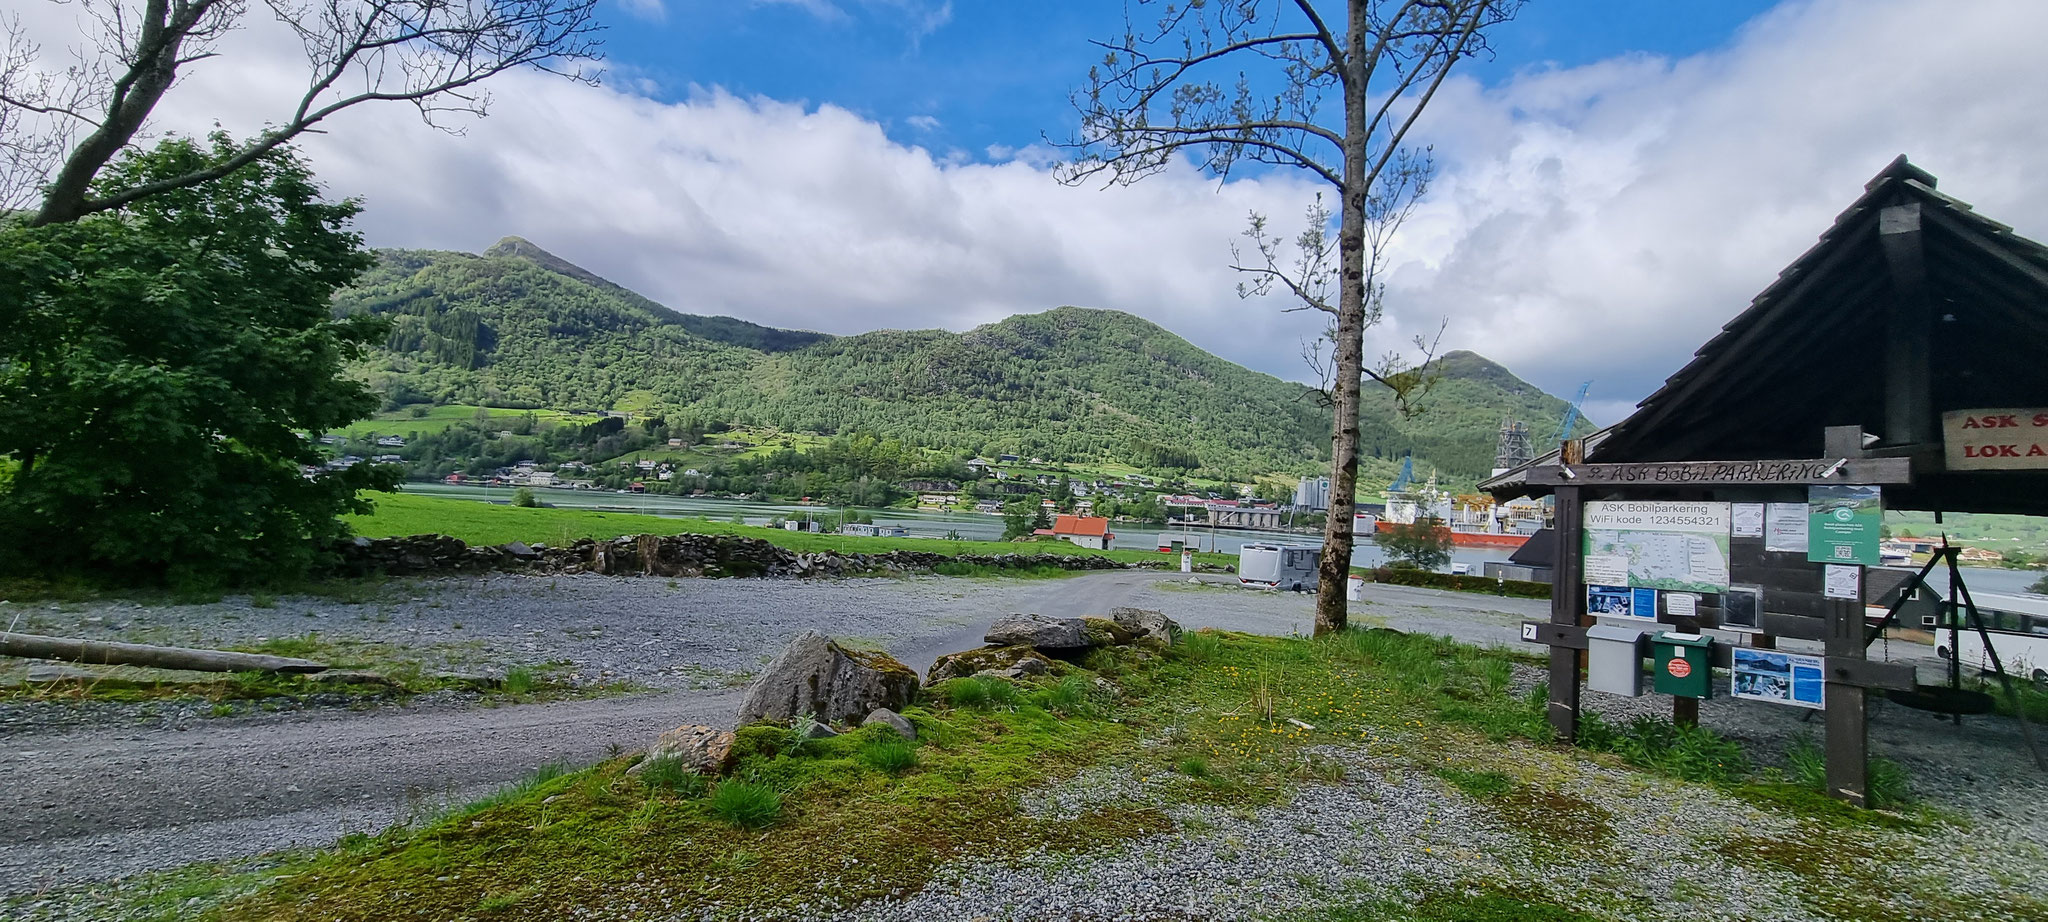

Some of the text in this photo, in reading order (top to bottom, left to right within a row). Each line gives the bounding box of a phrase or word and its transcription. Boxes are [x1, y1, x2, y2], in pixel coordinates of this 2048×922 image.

[1962, 415, 2019, 429] ASK
[1611, 465, 1650, 482] ASK
[1601, 503, 1708, 515] ASK Bobilparkering
[1590, 515, 1720, 525] WiFi kode 1234554321
[1525, 626, 1532, 636] 7
